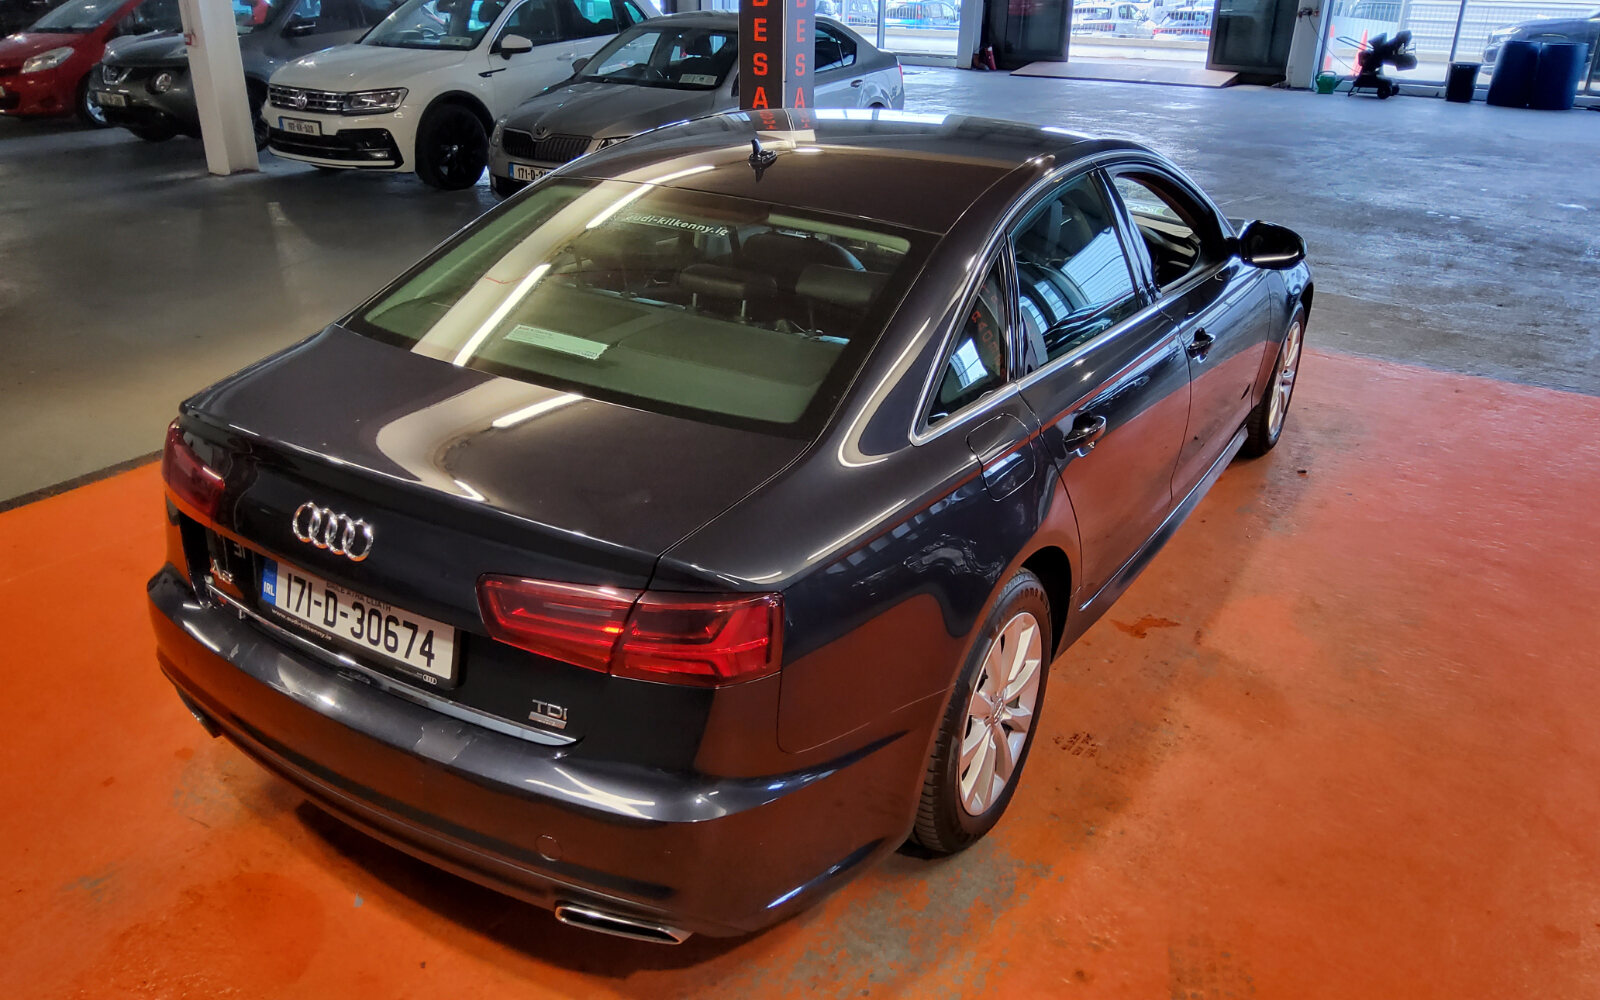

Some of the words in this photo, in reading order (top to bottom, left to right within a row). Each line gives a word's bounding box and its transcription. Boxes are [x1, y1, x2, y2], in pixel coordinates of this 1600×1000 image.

[752, 0, 769, 109] ESA
[794, 0, 806, 109] ESA
[263, 581, 276, 597] IRL
[286, 572, 436, 668] 171-D-30674
